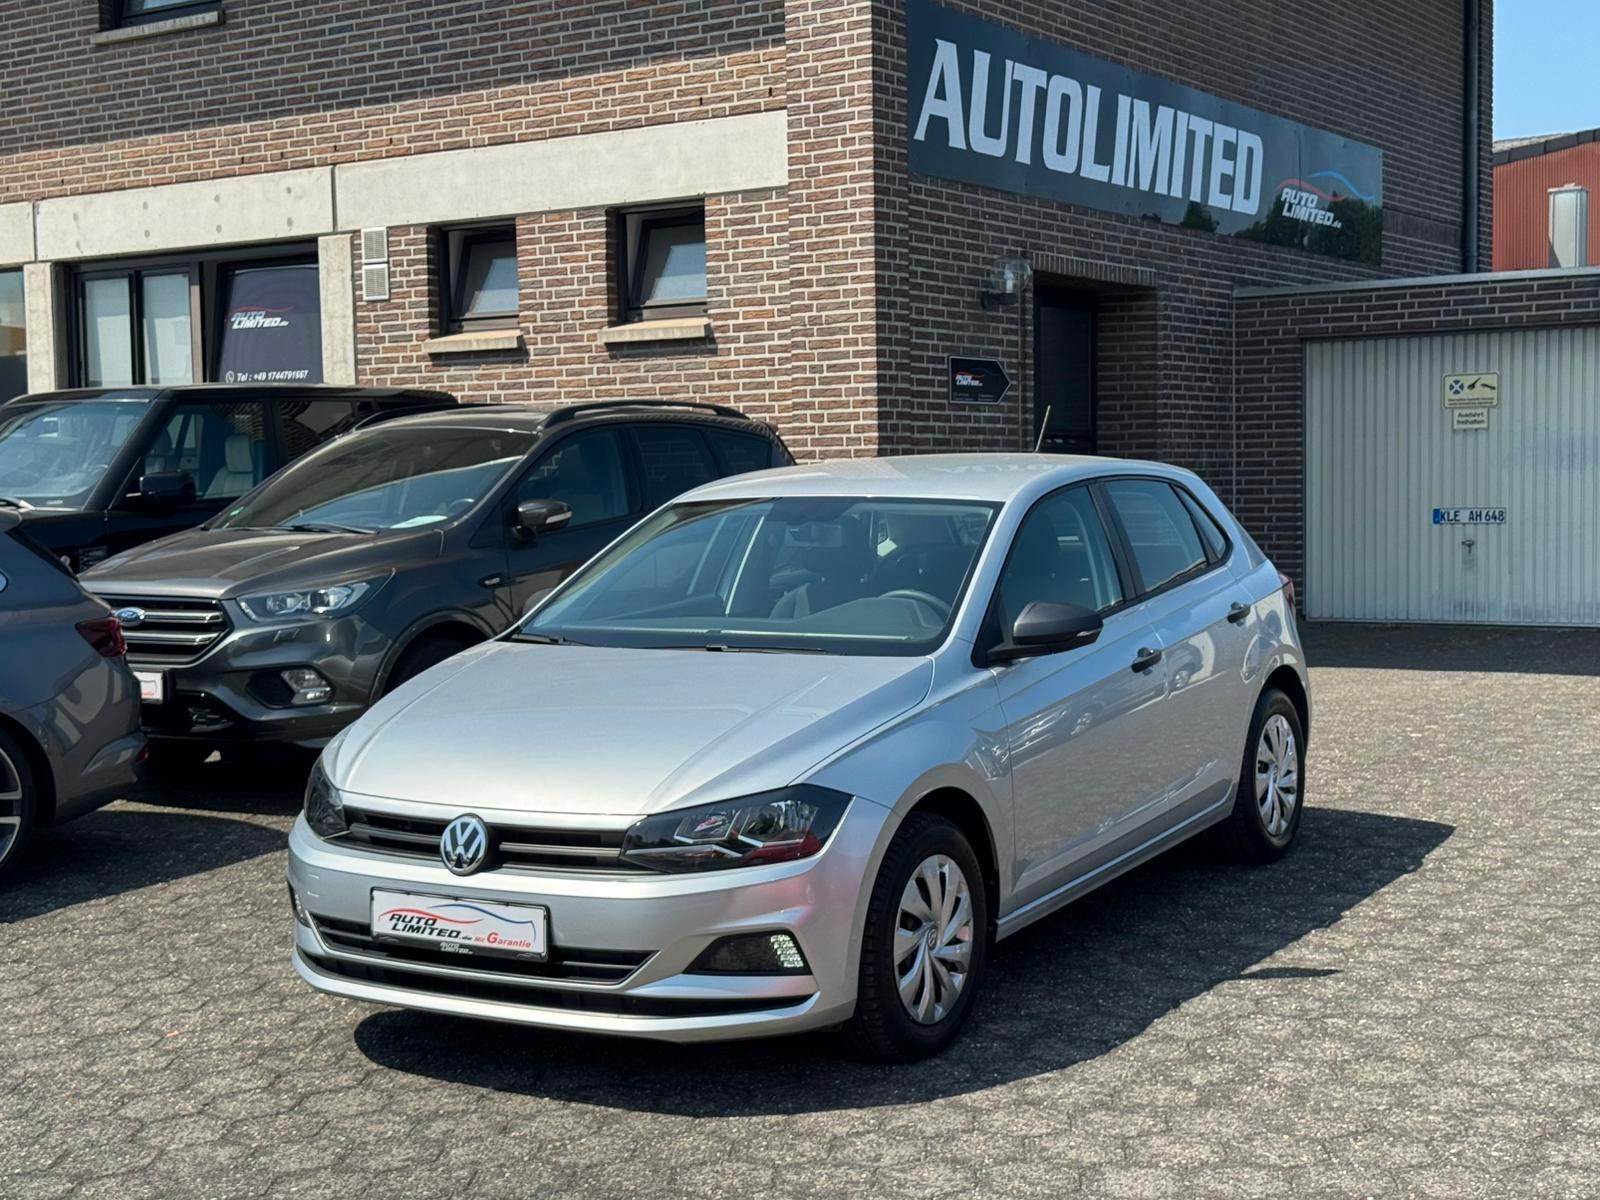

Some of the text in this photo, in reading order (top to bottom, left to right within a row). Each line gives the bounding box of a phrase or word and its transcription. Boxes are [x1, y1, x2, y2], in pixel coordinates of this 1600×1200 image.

[913, 38, 1264, 216] AUTOLIMITED
[1281, 187, 1318, 208] AUTO
[1440, 510, 1505, 522] KLE AH 648
[389, 913, 437, 926] AUTO
[487, 932, 532, 949] Garantie
